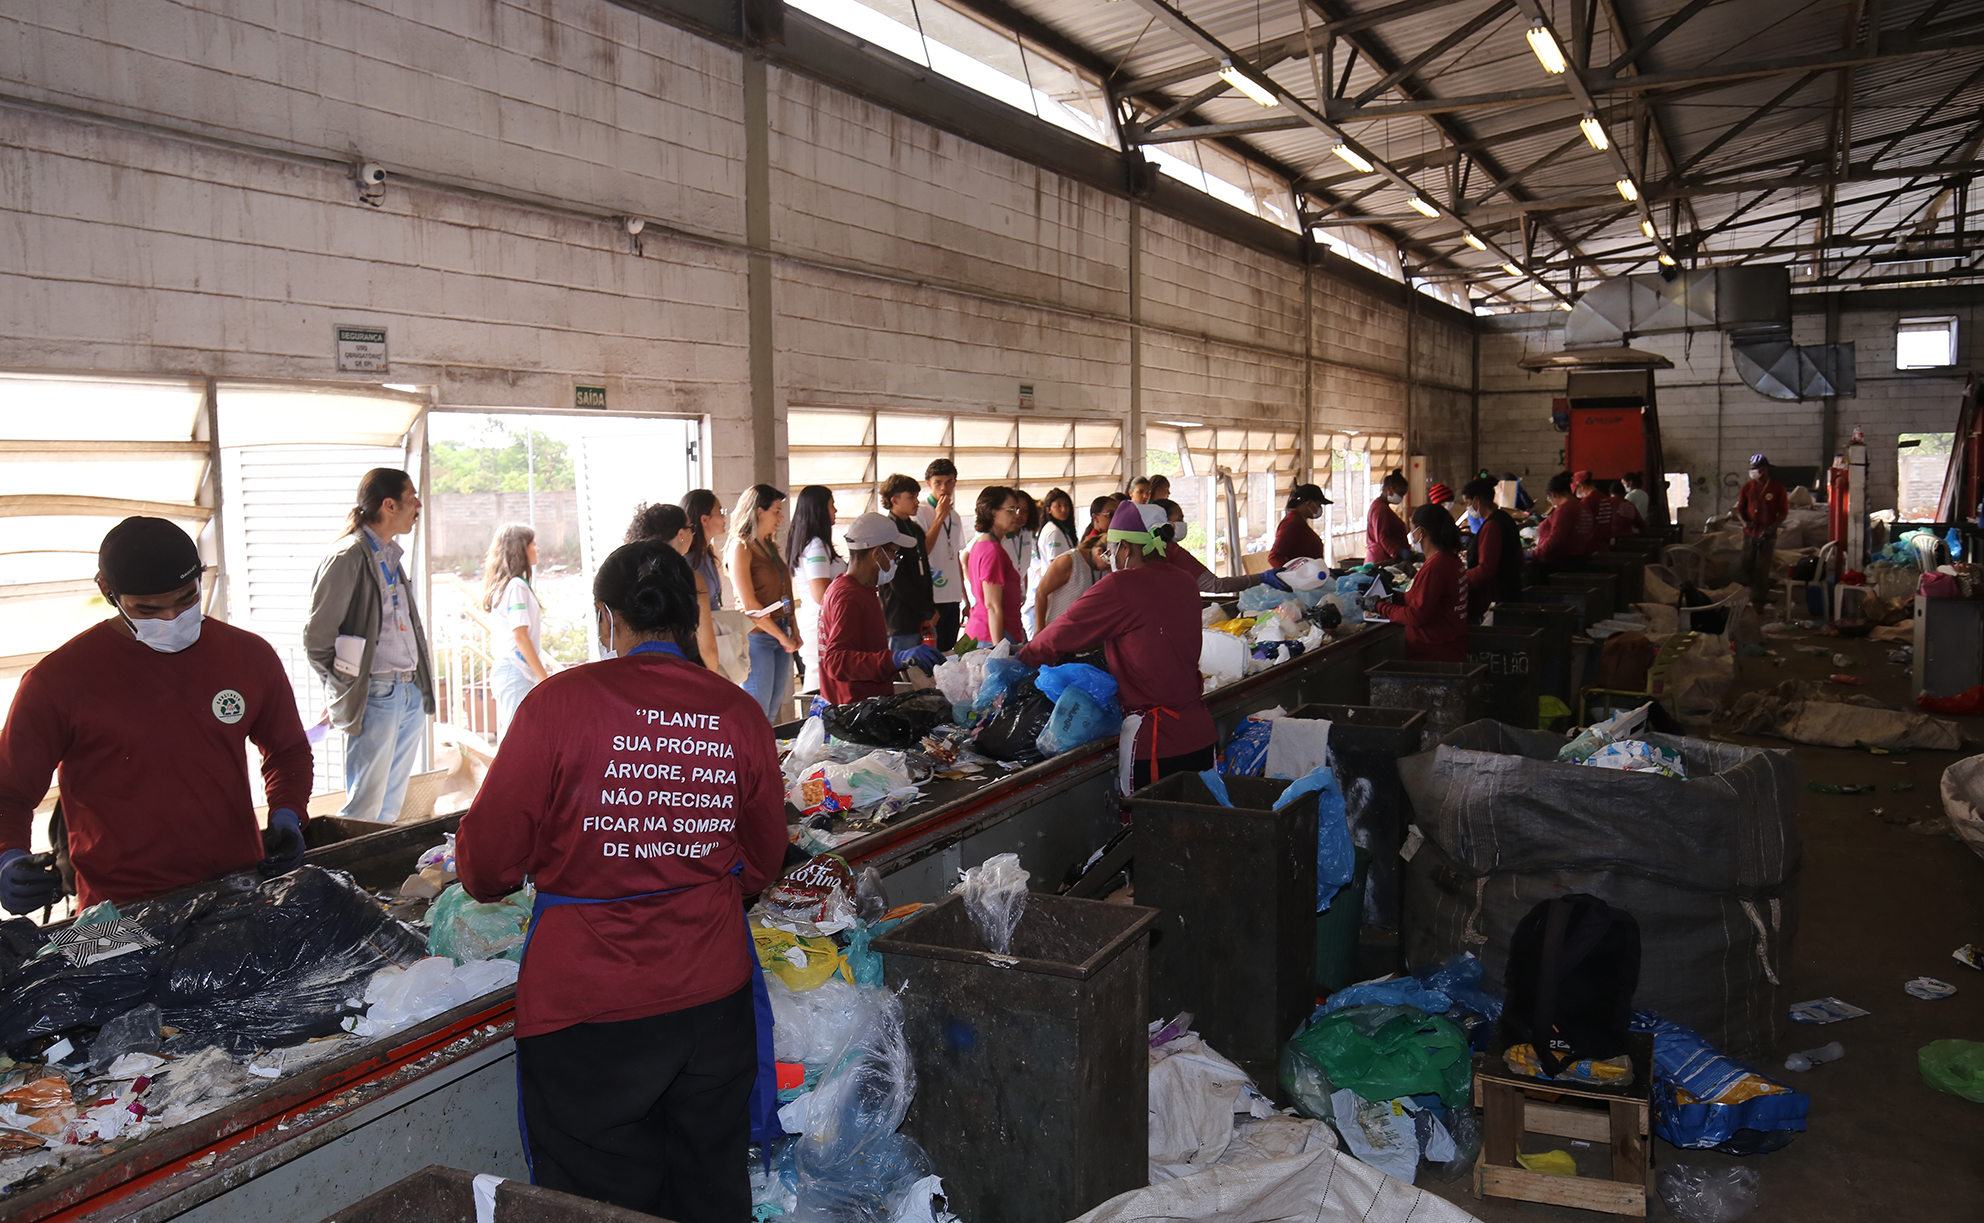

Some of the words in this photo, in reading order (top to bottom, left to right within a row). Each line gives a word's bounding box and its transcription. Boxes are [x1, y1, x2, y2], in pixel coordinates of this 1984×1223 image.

[341, 331, 383, 342] SEGURANÇA
[576, 389, 605, 406] SAÍDA
[612, 735, 652, 752] SUA
[656, 736, 735, 759] PRÓPRIA
[604, 759, 687, 783] ÁRVORE,
[691, 767, 737, 785] PARA
[601, 787, 643, 806] NÃO
[647, 790, 734, 809] PRECISAR
[583, 816, 640, 833] FICAR
[643, 816, 667, 832] NA
[672, 818, 737, 834] SOMBRA
[603, 842, 629, 858] DE
